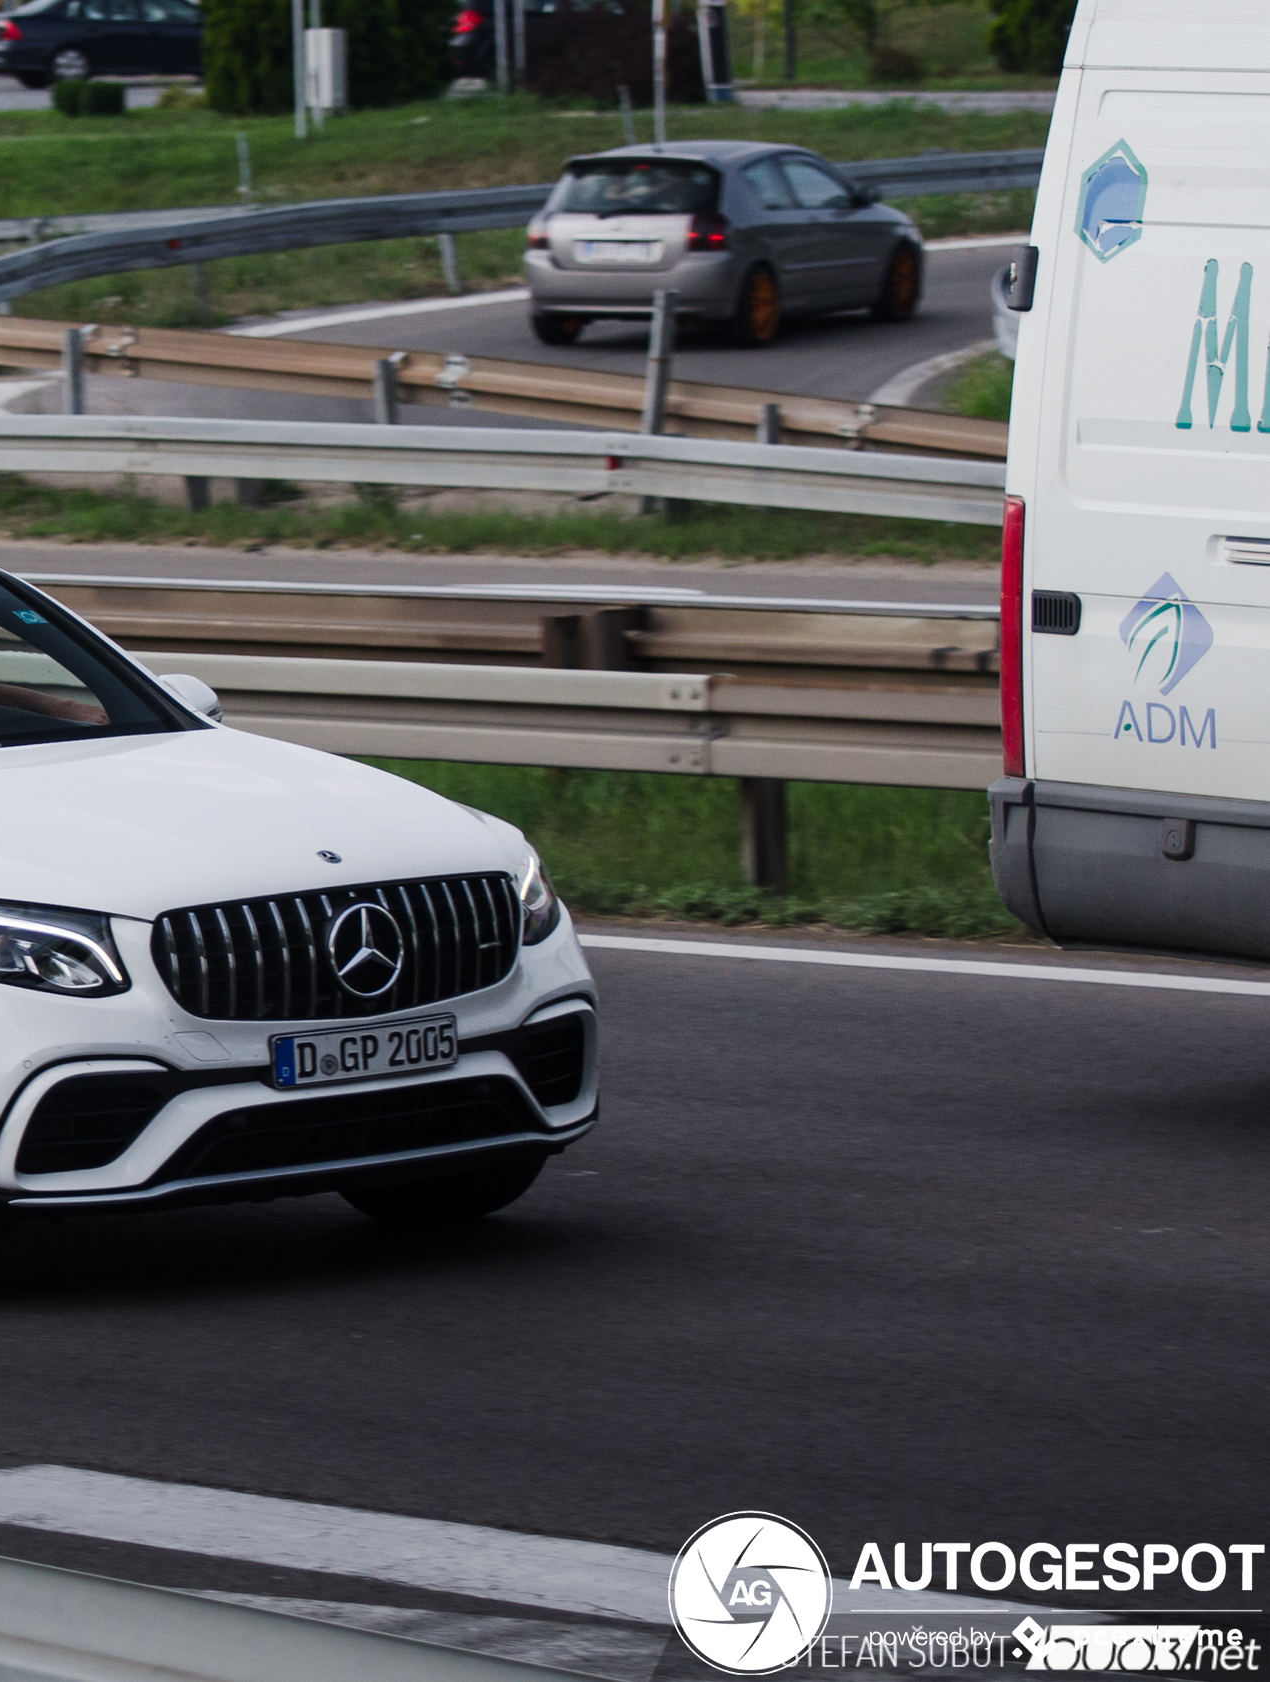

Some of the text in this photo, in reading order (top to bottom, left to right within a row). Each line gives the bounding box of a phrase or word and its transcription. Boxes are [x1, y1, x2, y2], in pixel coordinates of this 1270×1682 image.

[1113, 700, 1217, 750] ADM
[296, 1022, 454, 1078] D GP 2005
